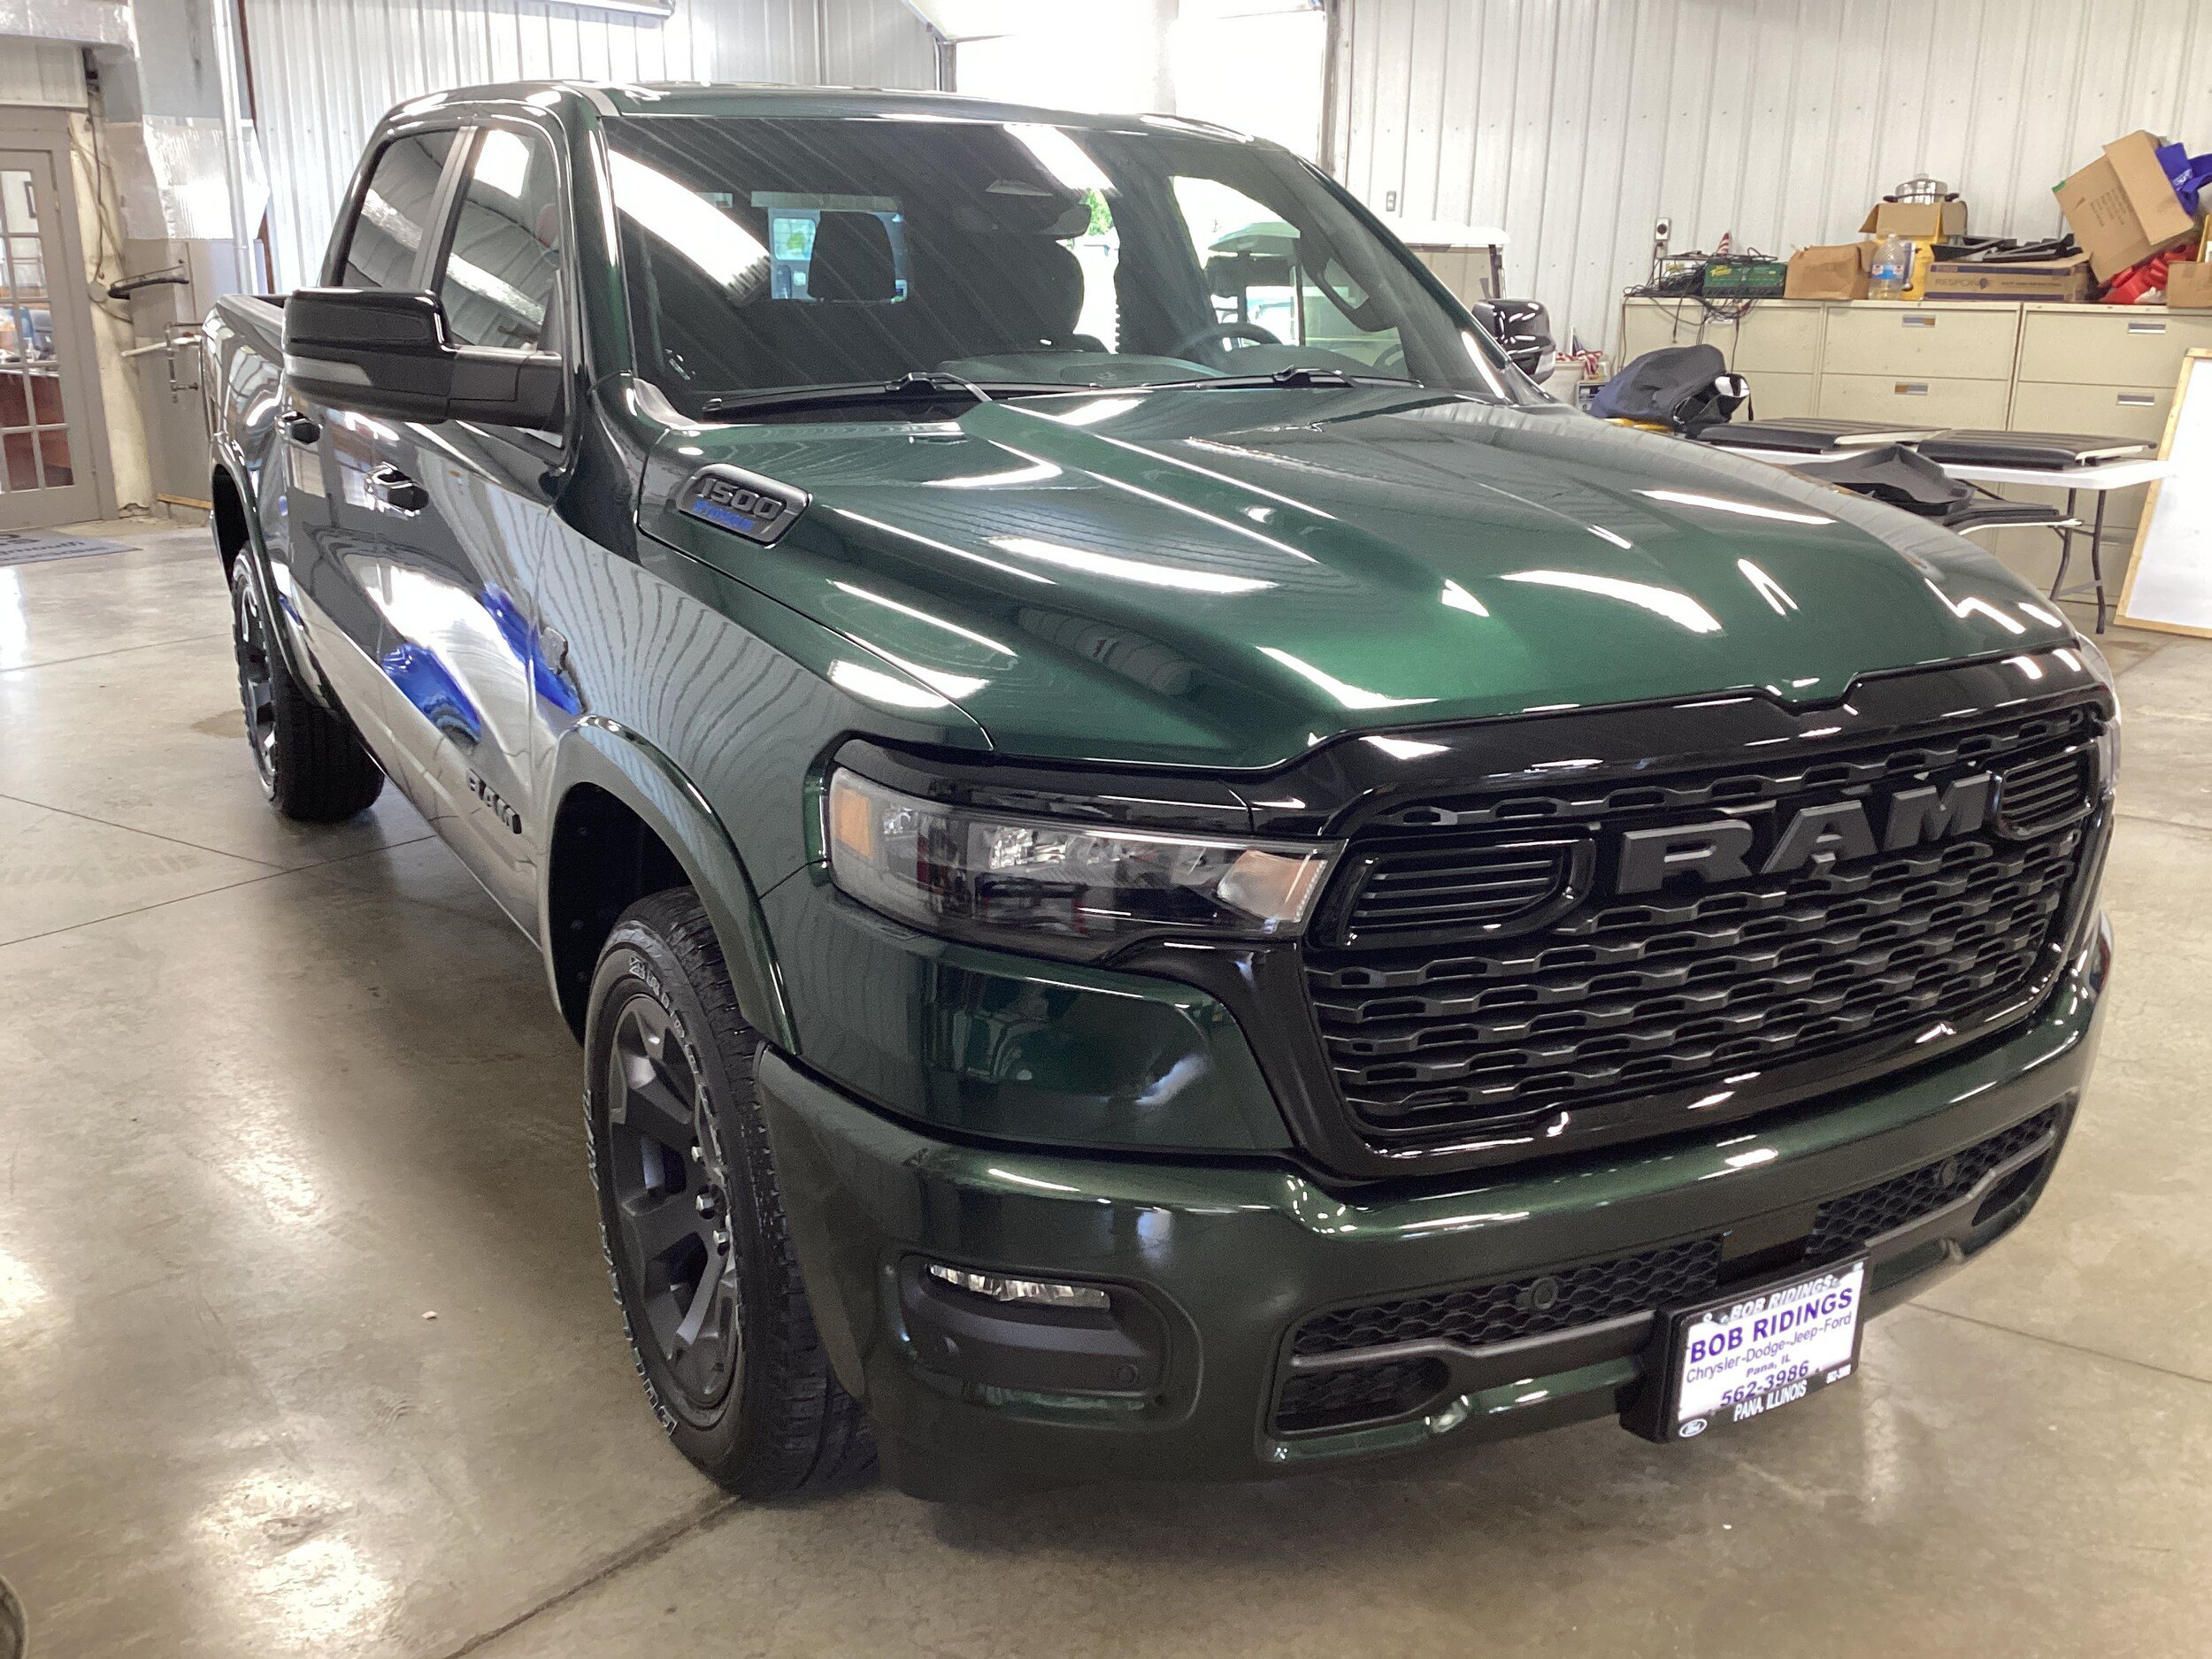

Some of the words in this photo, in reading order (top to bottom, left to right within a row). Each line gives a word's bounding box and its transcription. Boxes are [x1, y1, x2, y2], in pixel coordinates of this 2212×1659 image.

[698, 478, 787, 520] 1500
[1617, 772, 1991, 895] RAM
[1689, 1326, 1743, 1363] BOB
[1753, 1287, 1853, 1342] RIDINGS
[1730, 1297, 1766, 1320] BOB
[1686, 1312, 1852, 1384] Chrysler-Dodge-Jeep-Ford
[1746, 1361, 1777, 1378] Pana,
[1781, 1354, 1791, 1364] IL
[1720, 1360, 1809, 1407] 562-3986
[1766, 1379, 1808, 1410] ILLINOIS
